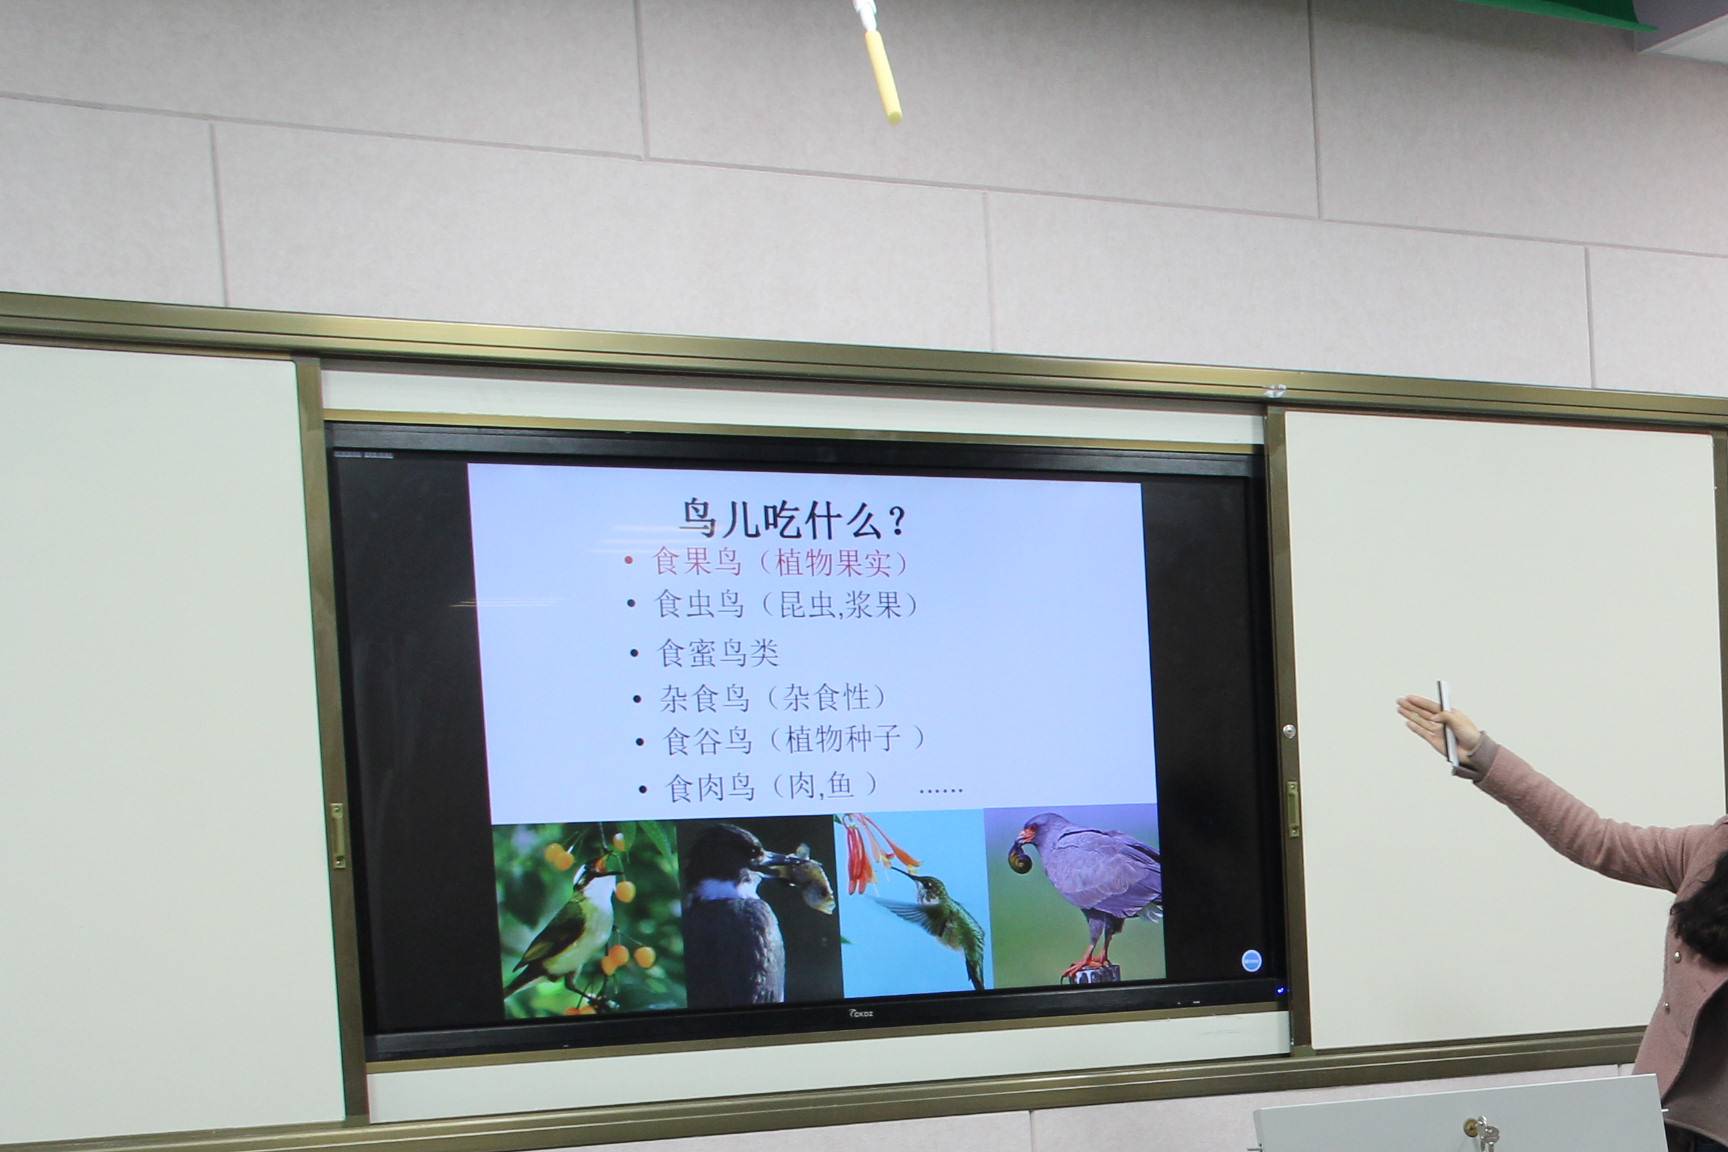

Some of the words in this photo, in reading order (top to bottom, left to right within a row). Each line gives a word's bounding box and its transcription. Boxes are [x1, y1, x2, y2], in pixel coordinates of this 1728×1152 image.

[653, 546, 906, 578] 食果鸟（植物果实）
[657, 638, 779, 668] 食蜜鸟类
[660, 683, 885, 714] 杂食鸟（杂食性）
